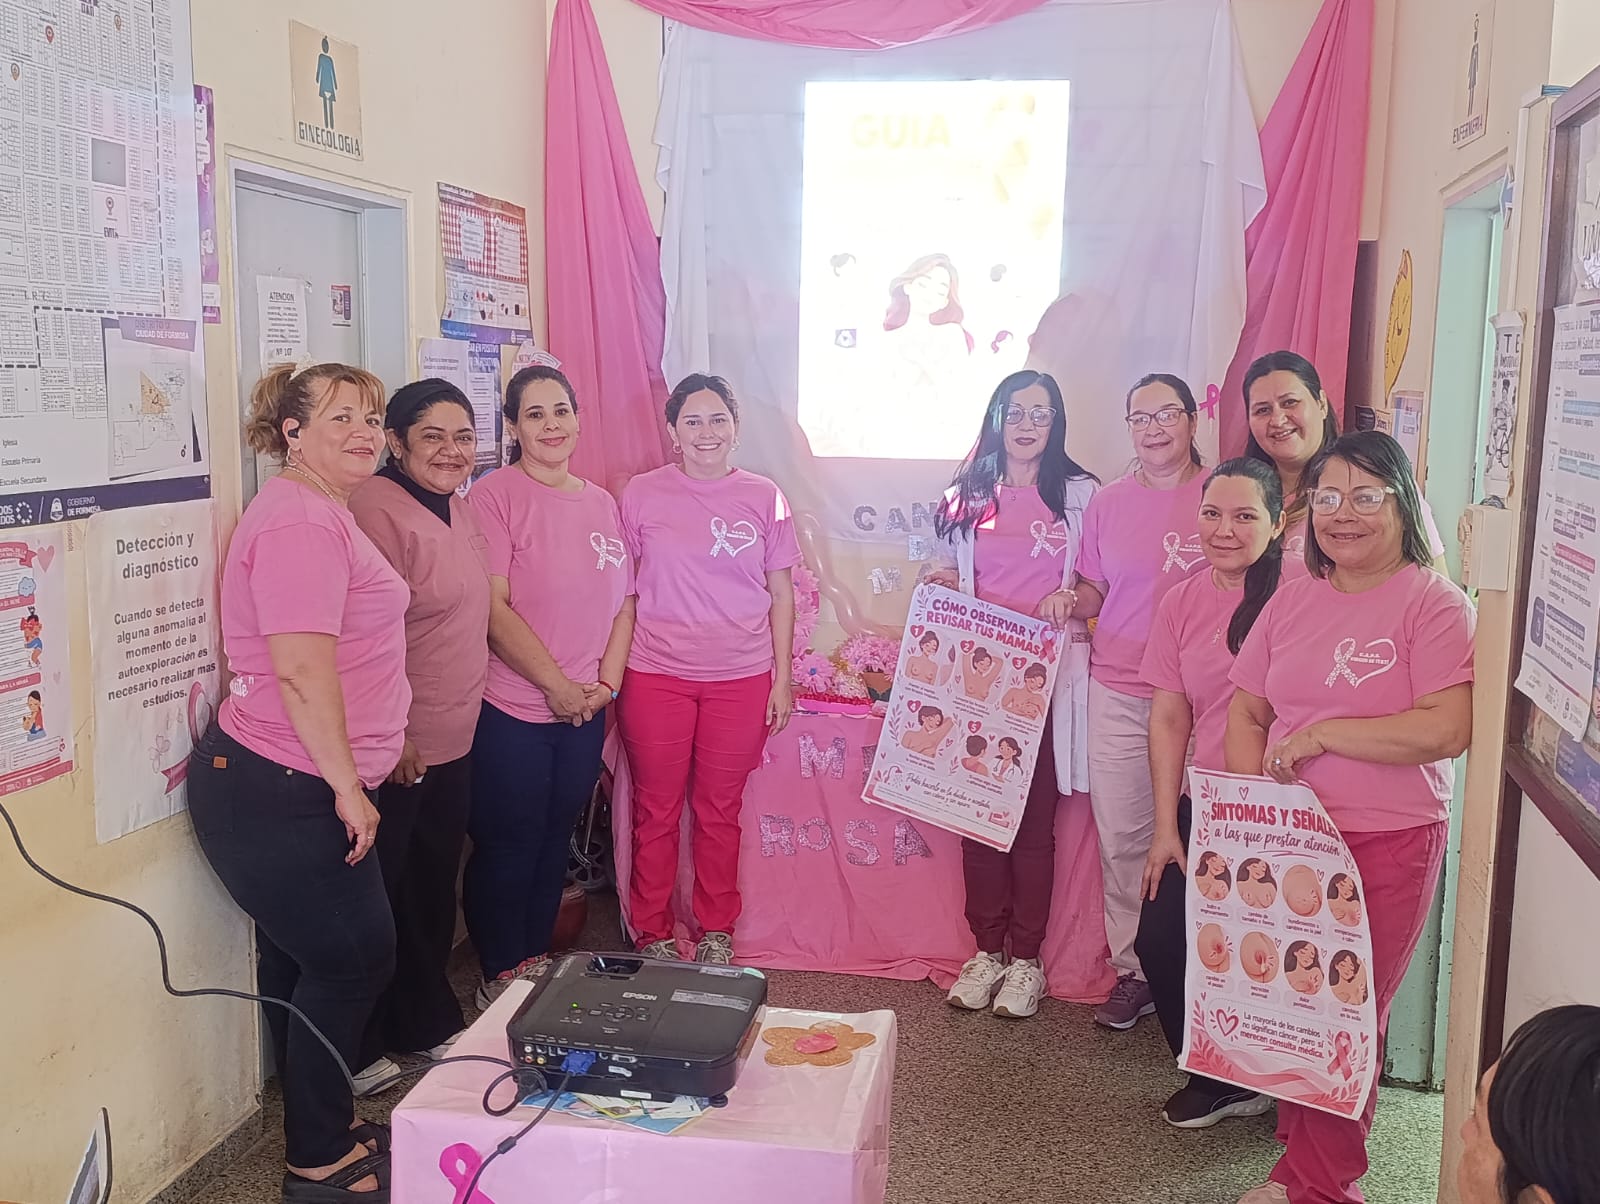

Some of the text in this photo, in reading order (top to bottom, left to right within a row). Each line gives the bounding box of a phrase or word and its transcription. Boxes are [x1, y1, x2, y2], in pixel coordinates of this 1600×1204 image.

[298, 121, 360, 156] GINECOLOGIA
[67, 496, 95, 506] GOBIERNO
[67, 506, 101, 516] DE FORMOSA
[116, 532, 194, 555] Detección y
[122, 555, 198, 579] diagnóstico
[114, 597, 204, 624] Cuando se detecta
[932, 597, 1036, 640] CÓMO OBSERVAR Y
[117, 628, 150, 644] alguna
[198, 612, 206, 624] al
[927, 611, 1041, 656] REVISAR TUS MAMAS
[126, 633, 197, 659] momento de la
[118, 648, 208, 680] autoexploración es
[108, 662, 216, 700] necesario realizar mas
[143, 689, 187, 708] estudios.
[1211, 797, 1276, 825] SÍNTOMAS
[1280, 808, 1289, 827] Y
[760, 814, 932, 866] ROSA
[1215, 824, 1340, 856] a las que prestar atención
[622, 992, 658, 1000] EPSON
[1244, 1012, 1251, 1020] La
[1252, 1015, 1277, 1026] mayoría
[1287, 1022, 1295, 1032] los
[1251, 1023, 1278, 1037] significan
[1300, 1037, 1316, 1046] pero
[1240, 1030, 1268, 1043] merecen
[1270, 1038, 1296, 1050] consulta
